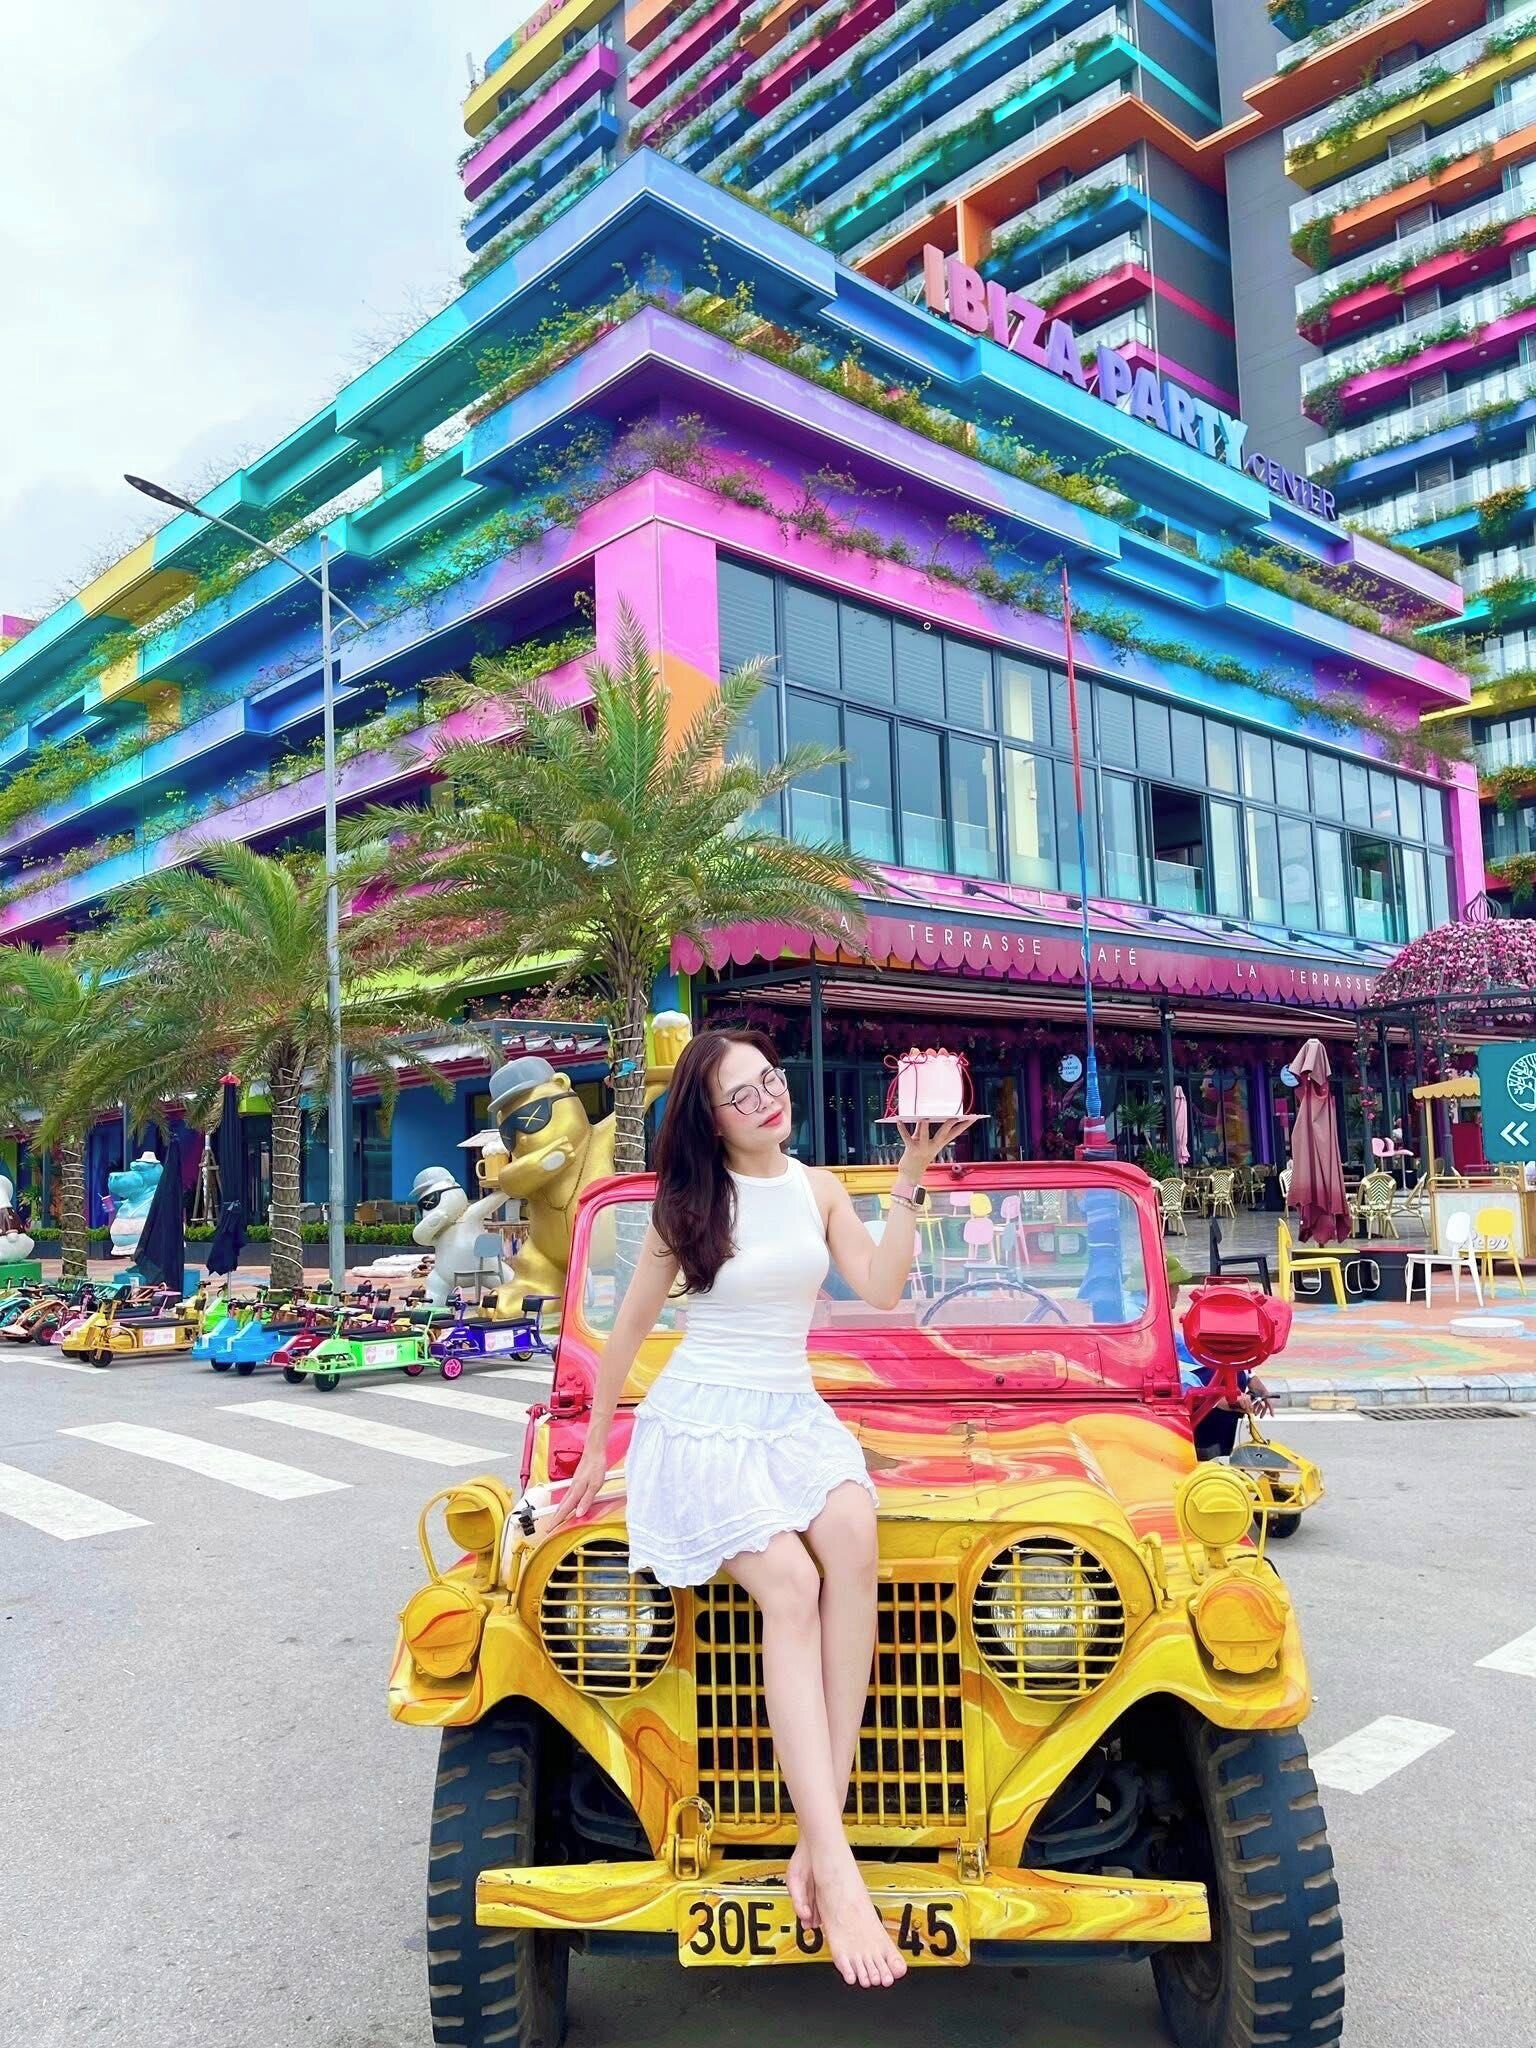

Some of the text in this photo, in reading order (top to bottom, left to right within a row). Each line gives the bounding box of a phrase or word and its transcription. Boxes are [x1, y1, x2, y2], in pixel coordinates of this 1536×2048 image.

[923, 243, 1336, 521] IBIZA PARTY CENTER
[908, 924, 1041, 956] TERRASSE
[1236, 963, 1371, 992] LA TERRASSE
[688, 1901, 958, 1957] 30E-645
